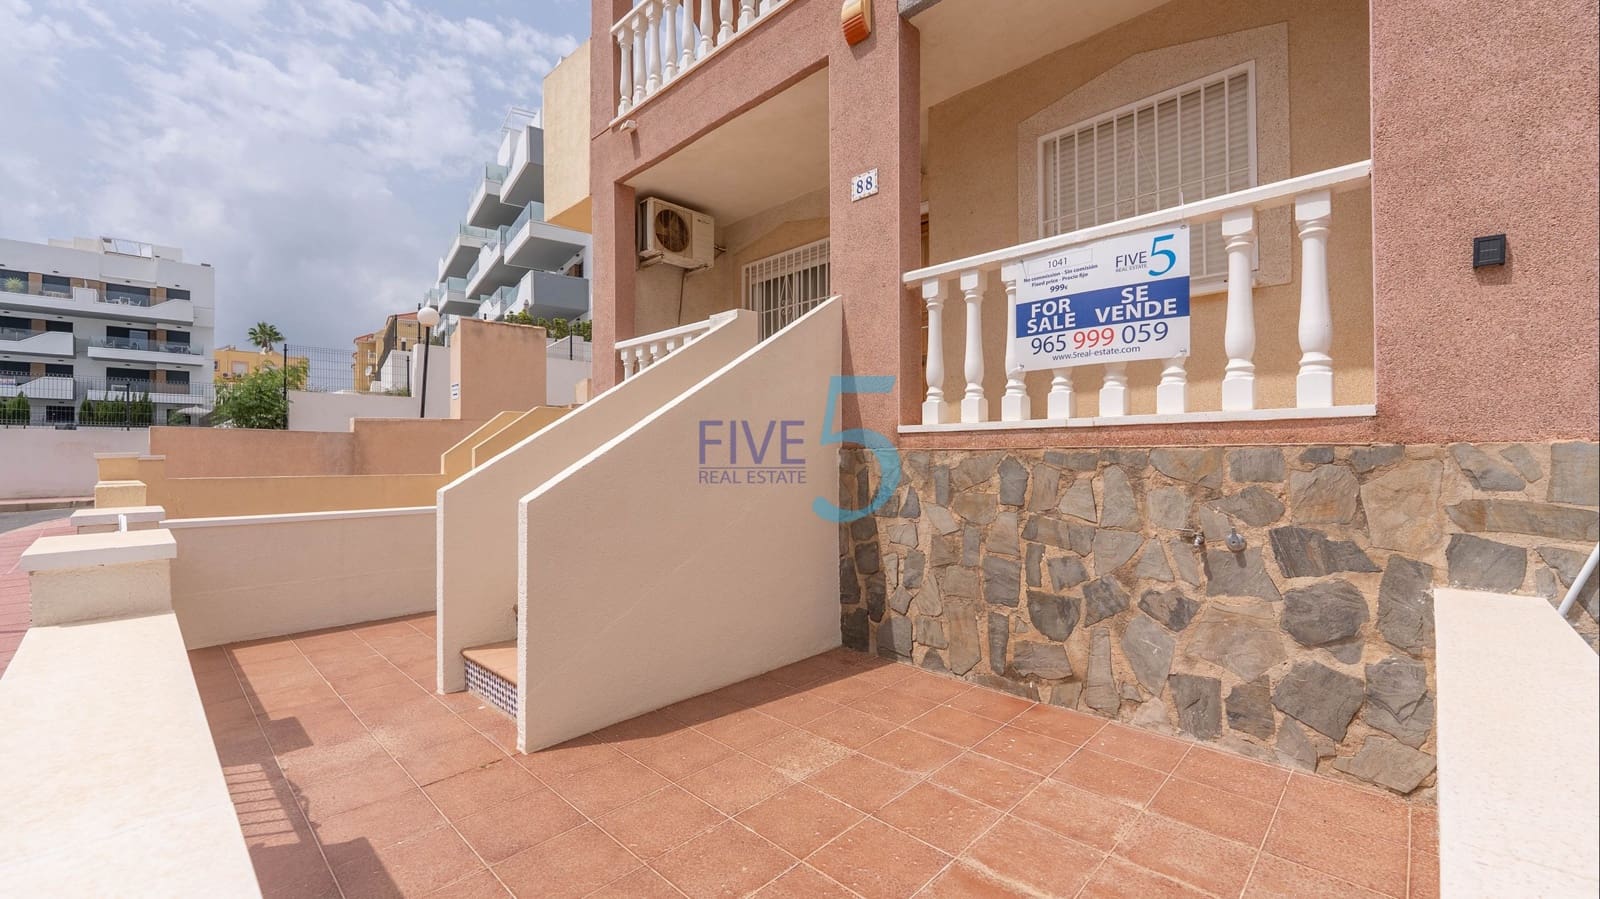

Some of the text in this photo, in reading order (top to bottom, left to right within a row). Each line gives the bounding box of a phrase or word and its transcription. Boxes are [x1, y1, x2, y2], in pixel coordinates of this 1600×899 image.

[857, 176, 873, 194] 88
[1048, 257, 1067, 269] 1041
[1115, 251, 1147, 268] FIVE
[1148, 234, 1176, 276] 5
[1121, 285, 1149, 304] SE
[1031, 298, 1071, 318] FOR
[1095, 298, 1177, 323] VENDE
[1027, 312, 1076, 334] SALE
[1031, 321, 1168, 355] 965 999 059
[1052, 345, 1141, 361] www.5real-estate.com
